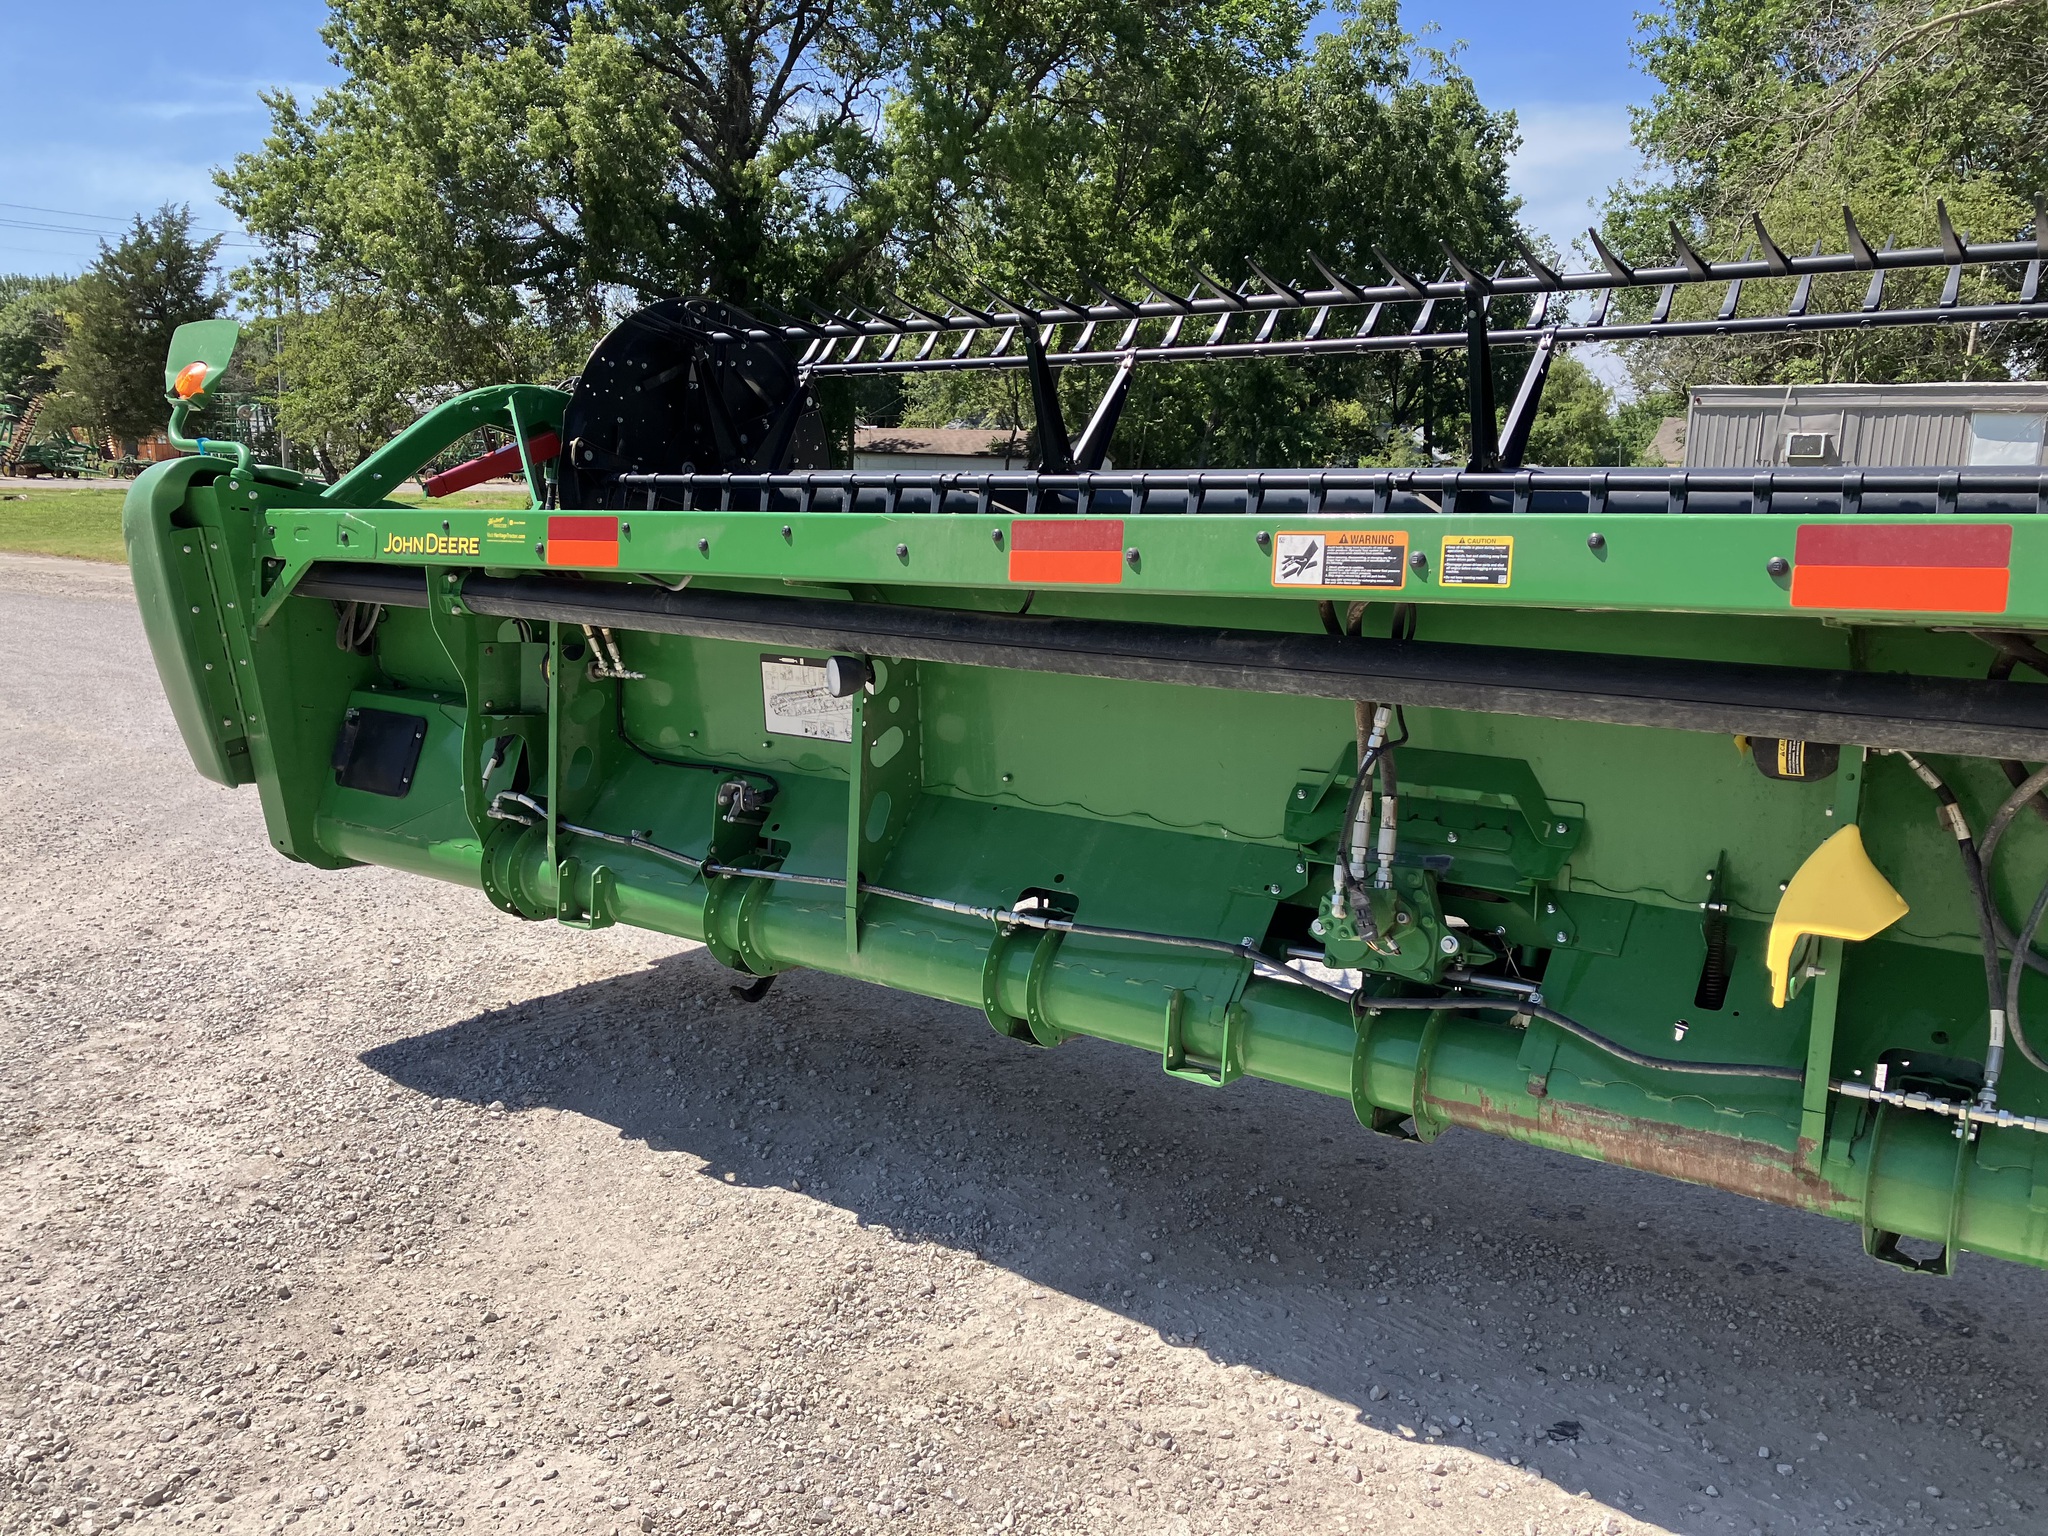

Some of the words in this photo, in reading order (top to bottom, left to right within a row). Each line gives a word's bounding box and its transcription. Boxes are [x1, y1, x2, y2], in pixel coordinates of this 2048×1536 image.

[383, 532, 425, 554] JOHN
[426, 532, 481, 556] DEERE
[1350, 534, 1395, 545] WARNING
